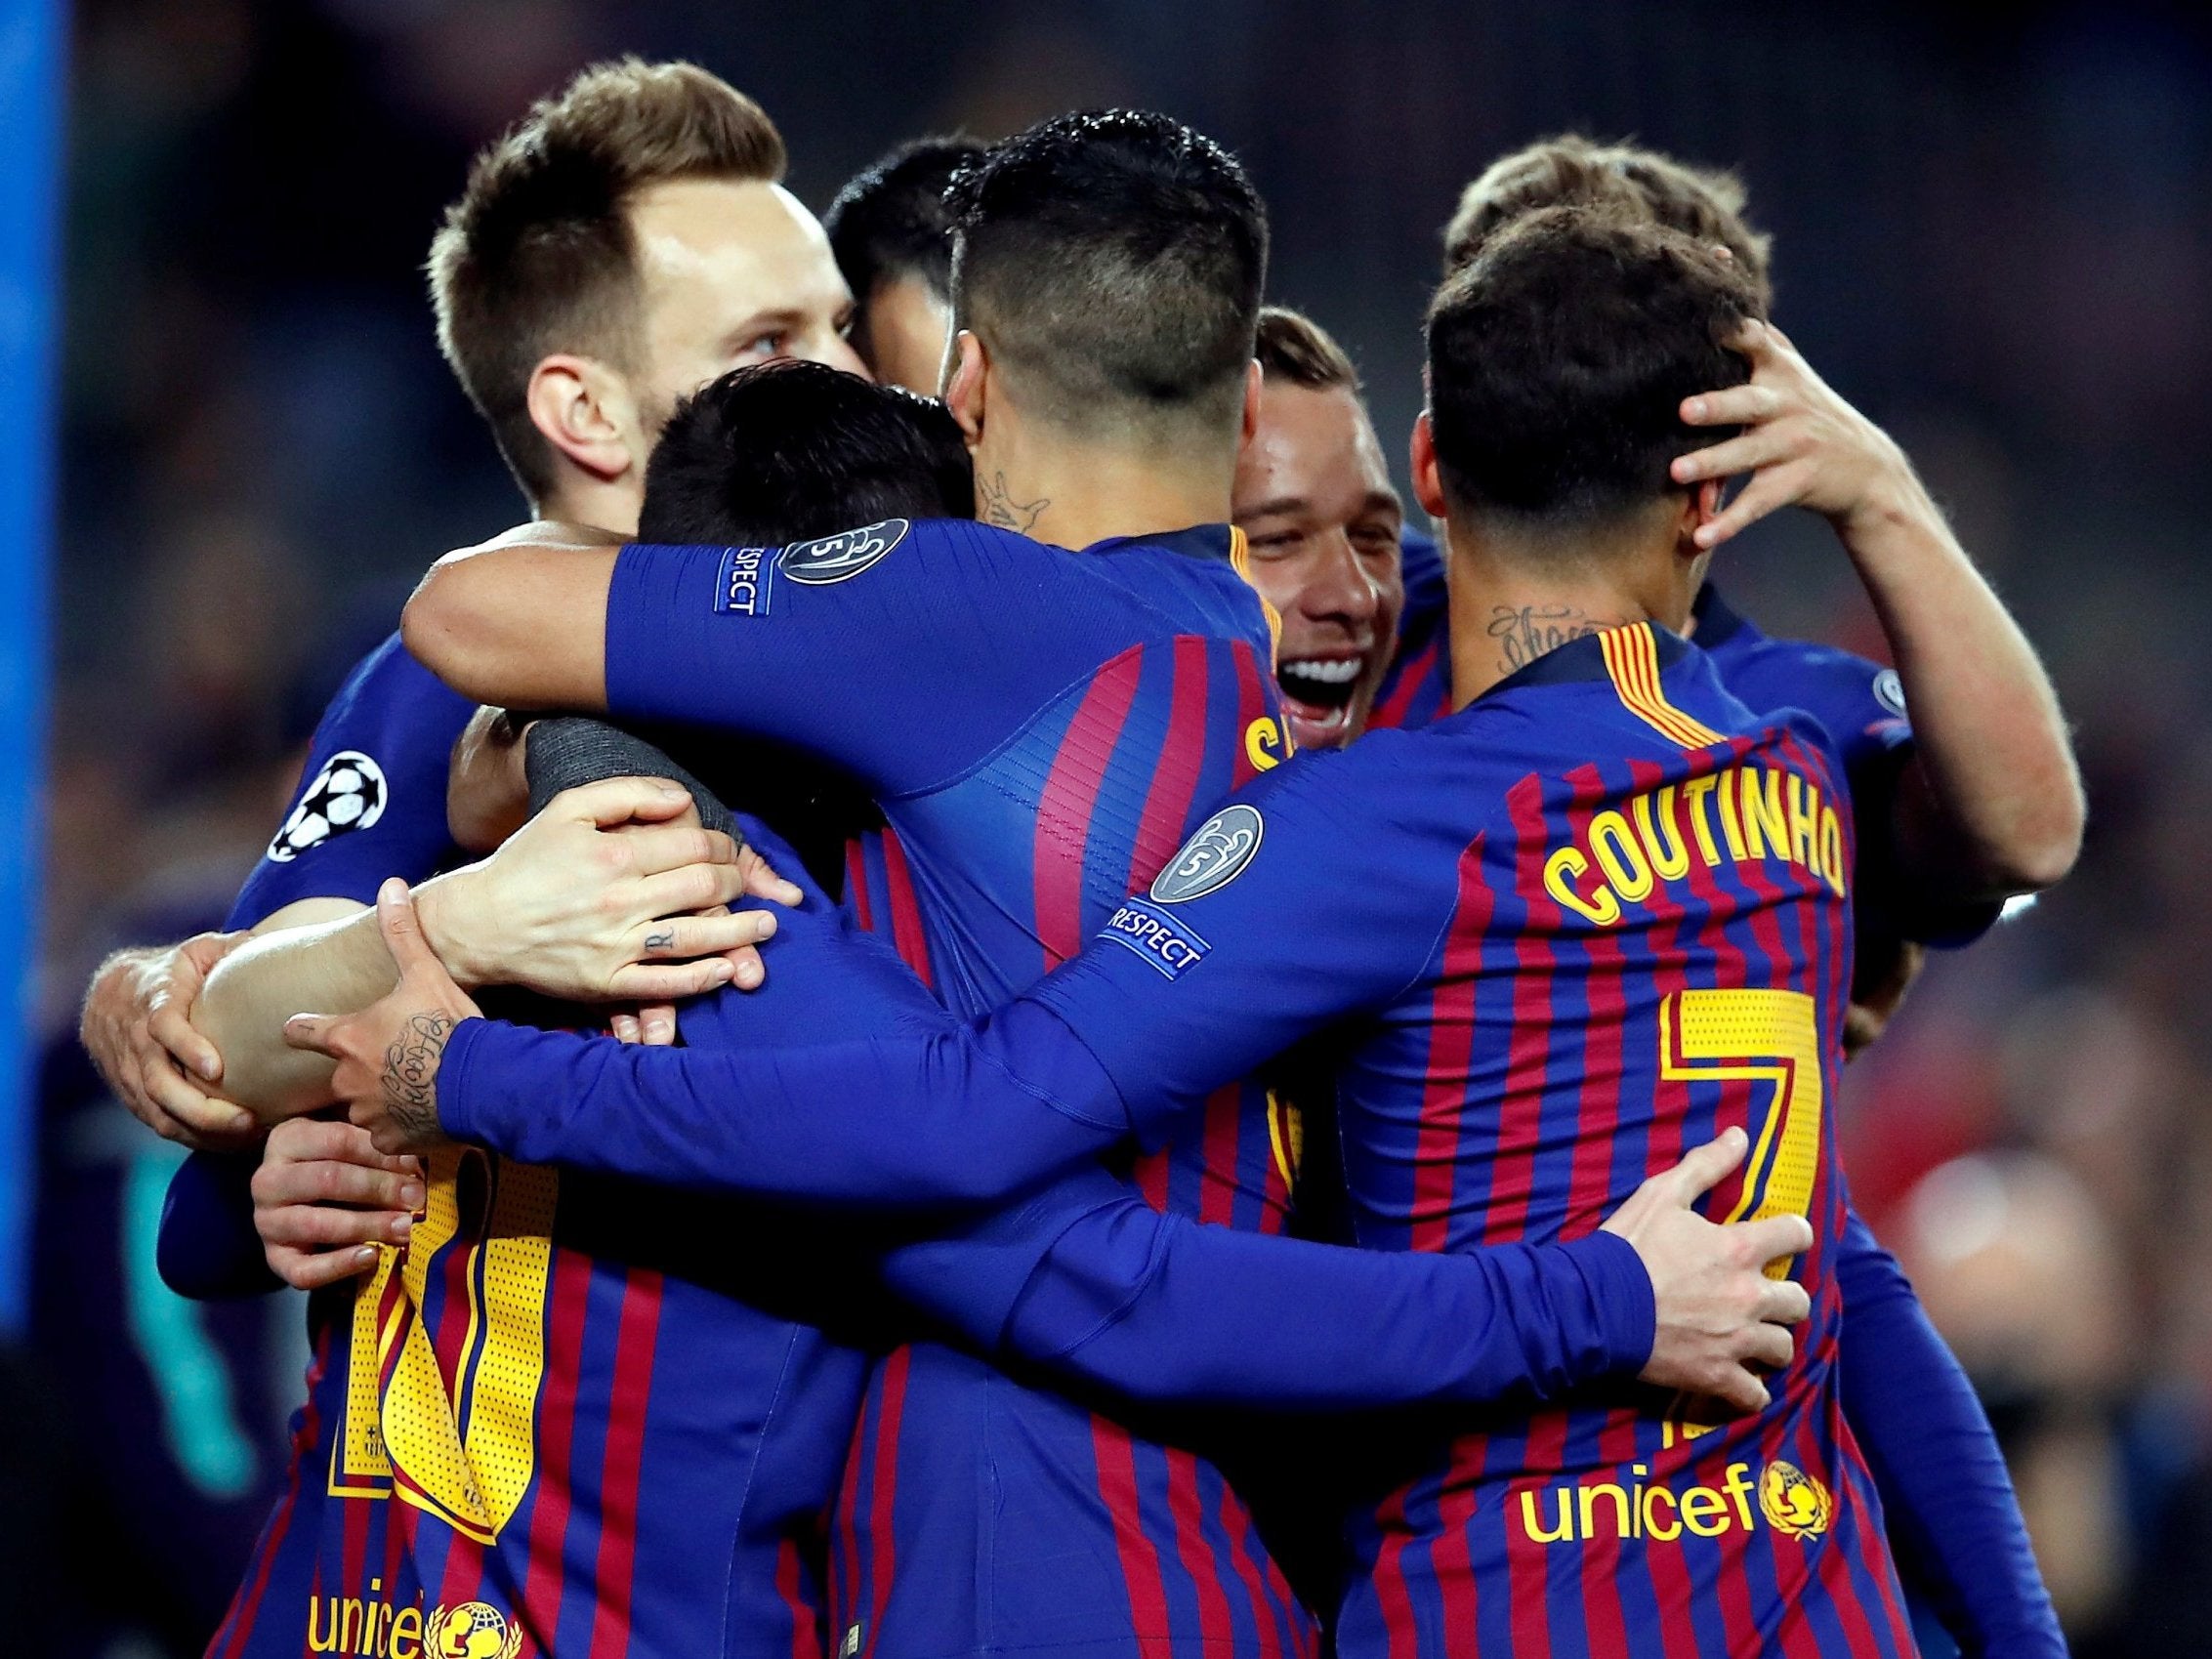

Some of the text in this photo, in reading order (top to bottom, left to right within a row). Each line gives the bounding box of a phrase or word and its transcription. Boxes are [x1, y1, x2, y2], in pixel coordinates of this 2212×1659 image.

[730, 547, 766, 616] ESPECT
[1179, 851, 1212, 877] 5
[1543, 767, 1846, 927] COUTINHO
[1107, 907, 1201, 969] RESPECT
[1660, 988, 1823, 1449] 7
[1520, 1462, 1755, 1543] unicef
[308, 1577, 425, 1659] unice
